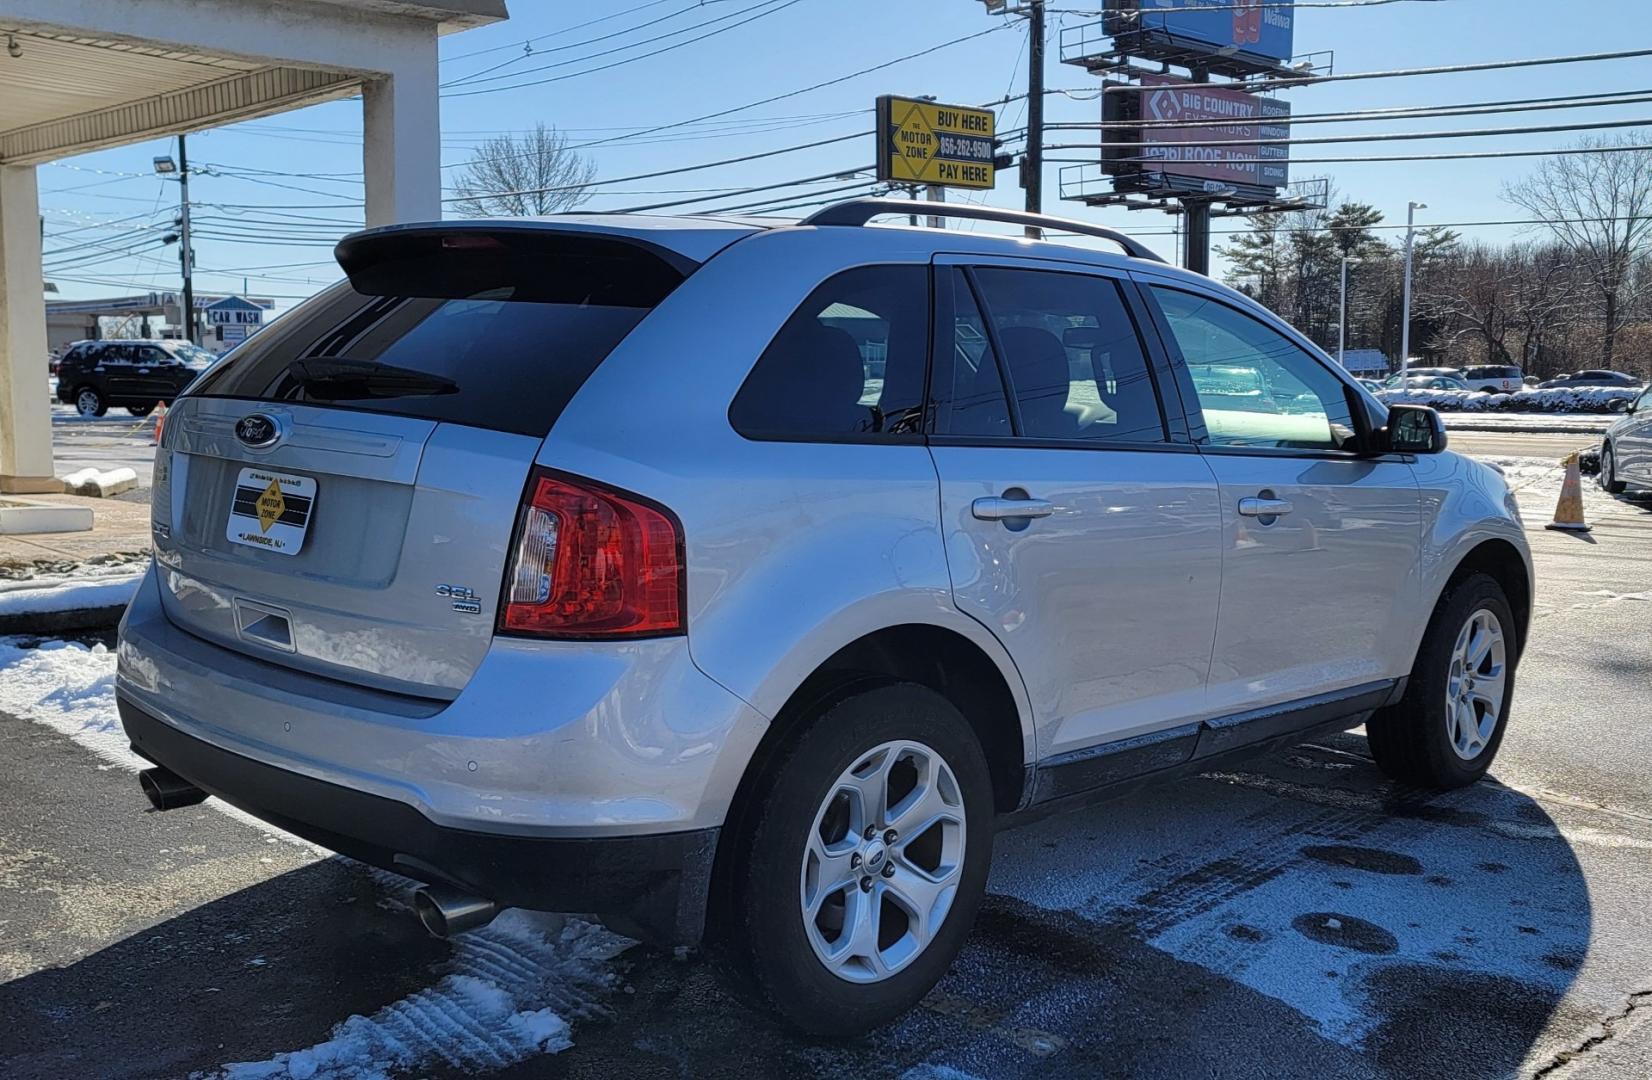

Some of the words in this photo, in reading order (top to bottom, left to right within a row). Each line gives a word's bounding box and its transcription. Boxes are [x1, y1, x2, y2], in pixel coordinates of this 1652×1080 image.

[1264, 9, 1290, 29] Wawa
[1183, 93, 1200, 110] BIG
[1204, 96, 1253, 118] COUNTRY
[938, 111, 959, 128] BUY
[962, 114, 987, 132] HERE
[1184, 112, 1251, 136] EXIORS
[901, 130, 931, 145] MOTOR
[1261, 125, 1288, 137] WINDOWS
[906, 146, 928, 159] ZONE
[940, 137, 991, 159] 856-262-9500
[1226, 151, 1256, 172] NOW
[939, 163, 959, 180] PAY
[962, 166, 987, 182] HERE
[1264, 166, 1284, 177] SIDING
[213, 311, 230, 323] CAR
[236, 312, 259, 324] WASH
[240, 417, 267, 438] Ford
[262, 497, 280, 508] MOTOR
[261, 508, 275, 519] ZONE
[436, 584, 480, 601] SEL
